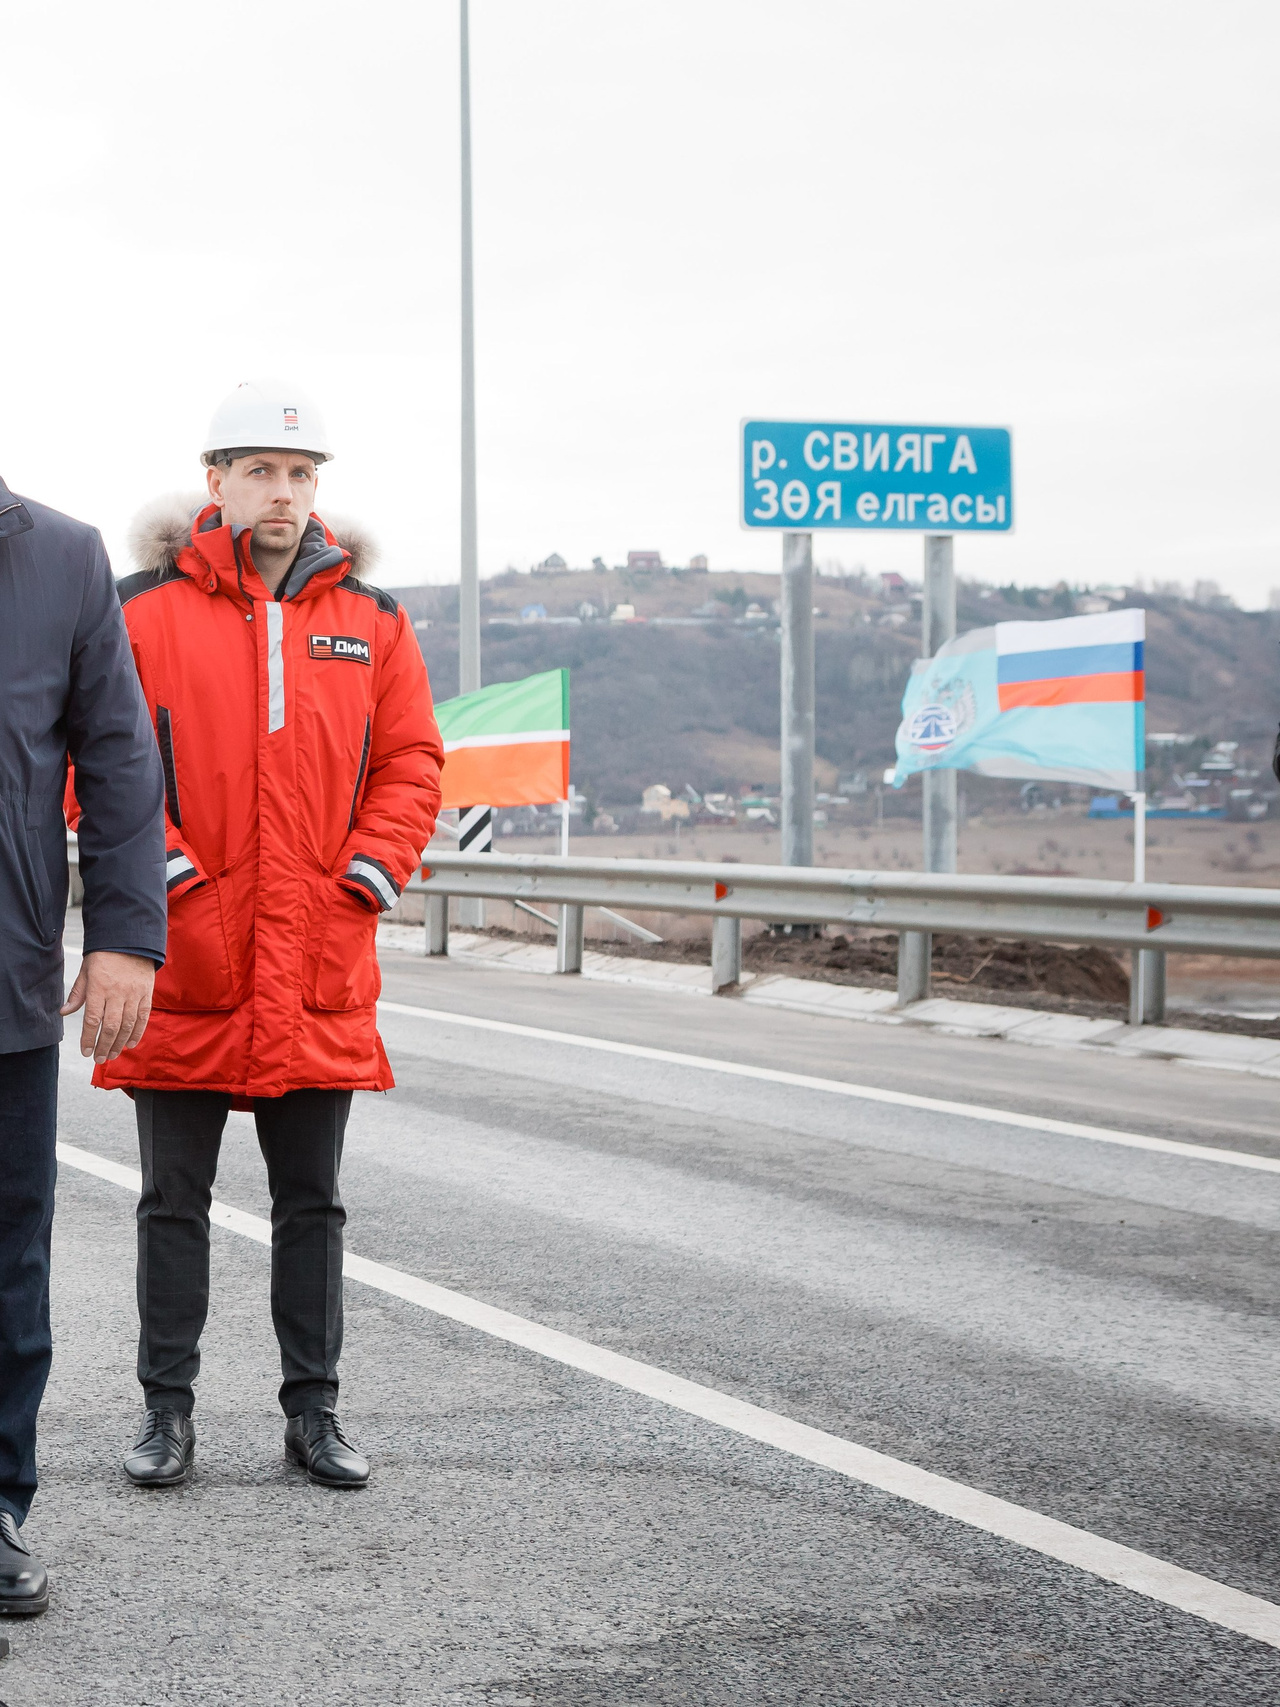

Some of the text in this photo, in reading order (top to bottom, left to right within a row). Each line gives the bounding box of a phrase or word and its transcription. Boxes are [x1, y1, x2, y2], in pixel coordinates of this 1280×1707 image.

[752, 430, 978, 480] р. СВИЯГА
[855, 491, 1006, 524] елгасы
